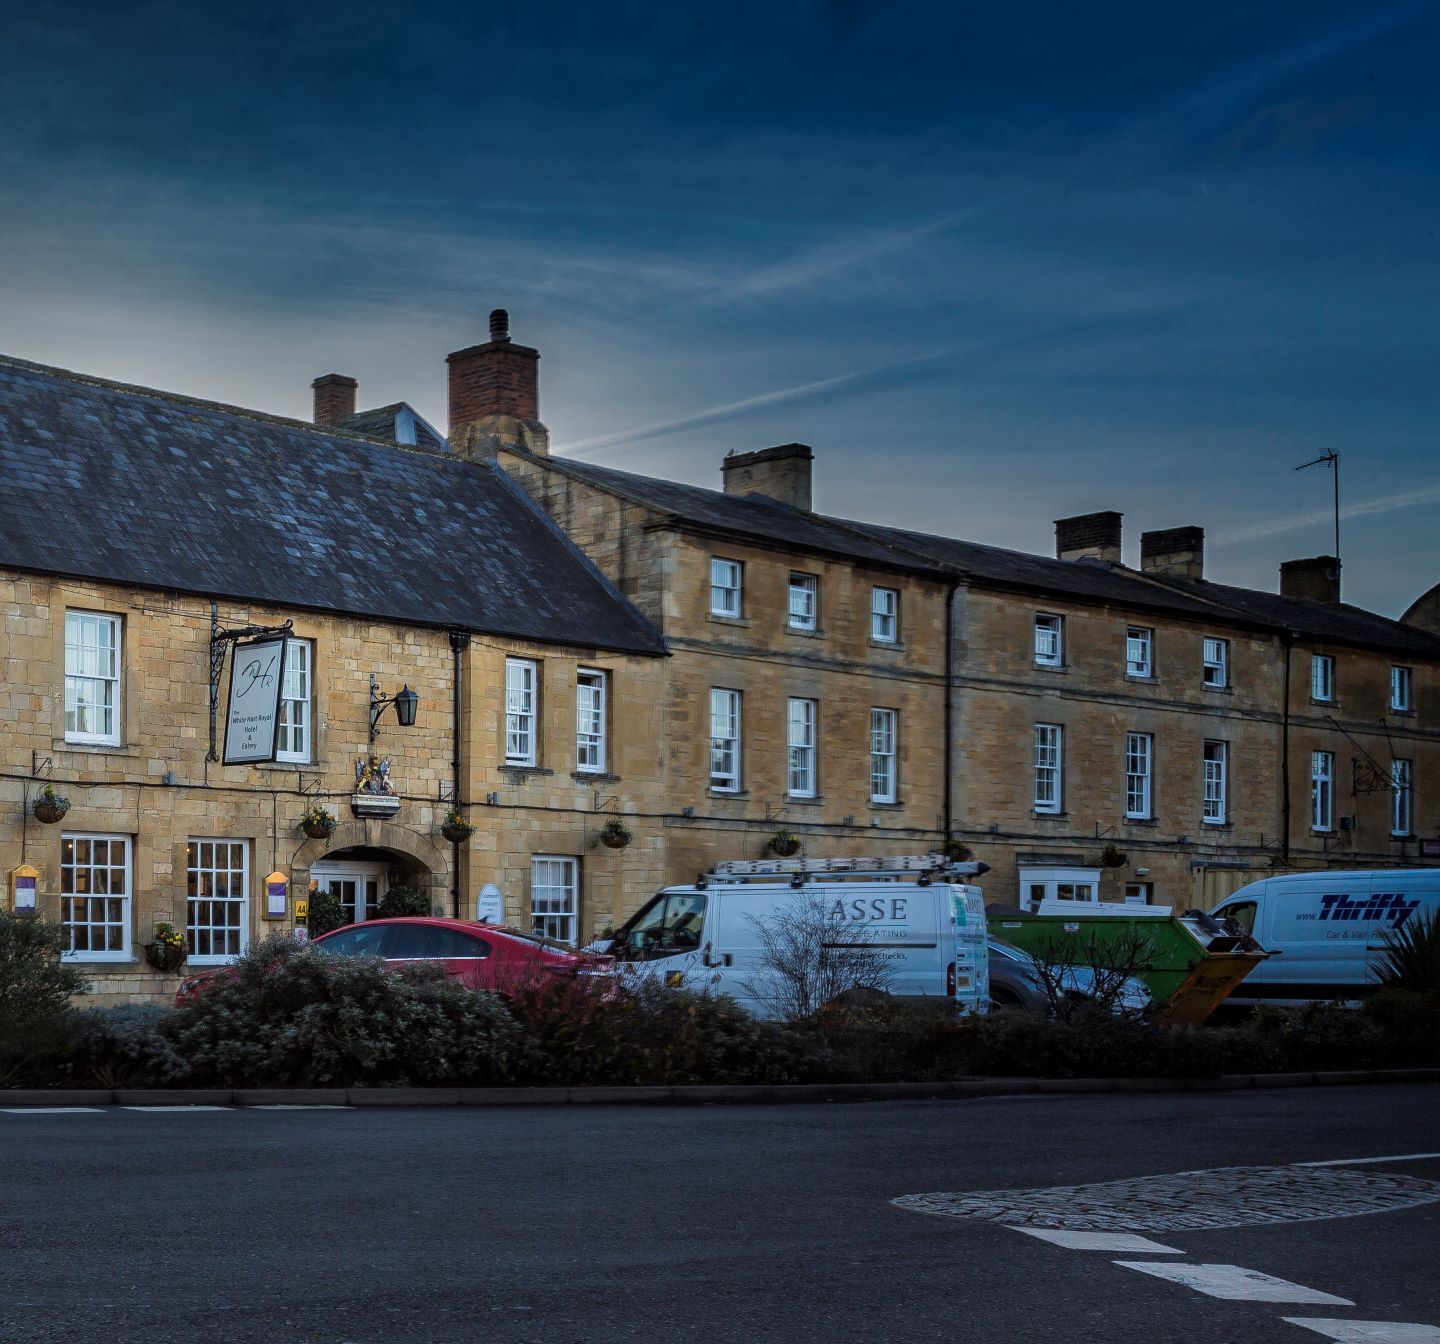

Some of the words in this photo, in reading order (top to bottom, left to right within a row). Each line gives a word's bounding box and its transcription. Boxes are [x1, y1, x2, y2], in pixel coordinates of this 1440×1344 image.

[258, 713, 272, 722] Royal
[244, 725, 258, 733] Hotel
[241, 742, 257, 750] Eatery
[297, 905, 306, 914] AA
[1326, 929, 1339, 939] Car
[1342, 930, 1348, 939] &
[1351, 930, 1367, 939] Van
